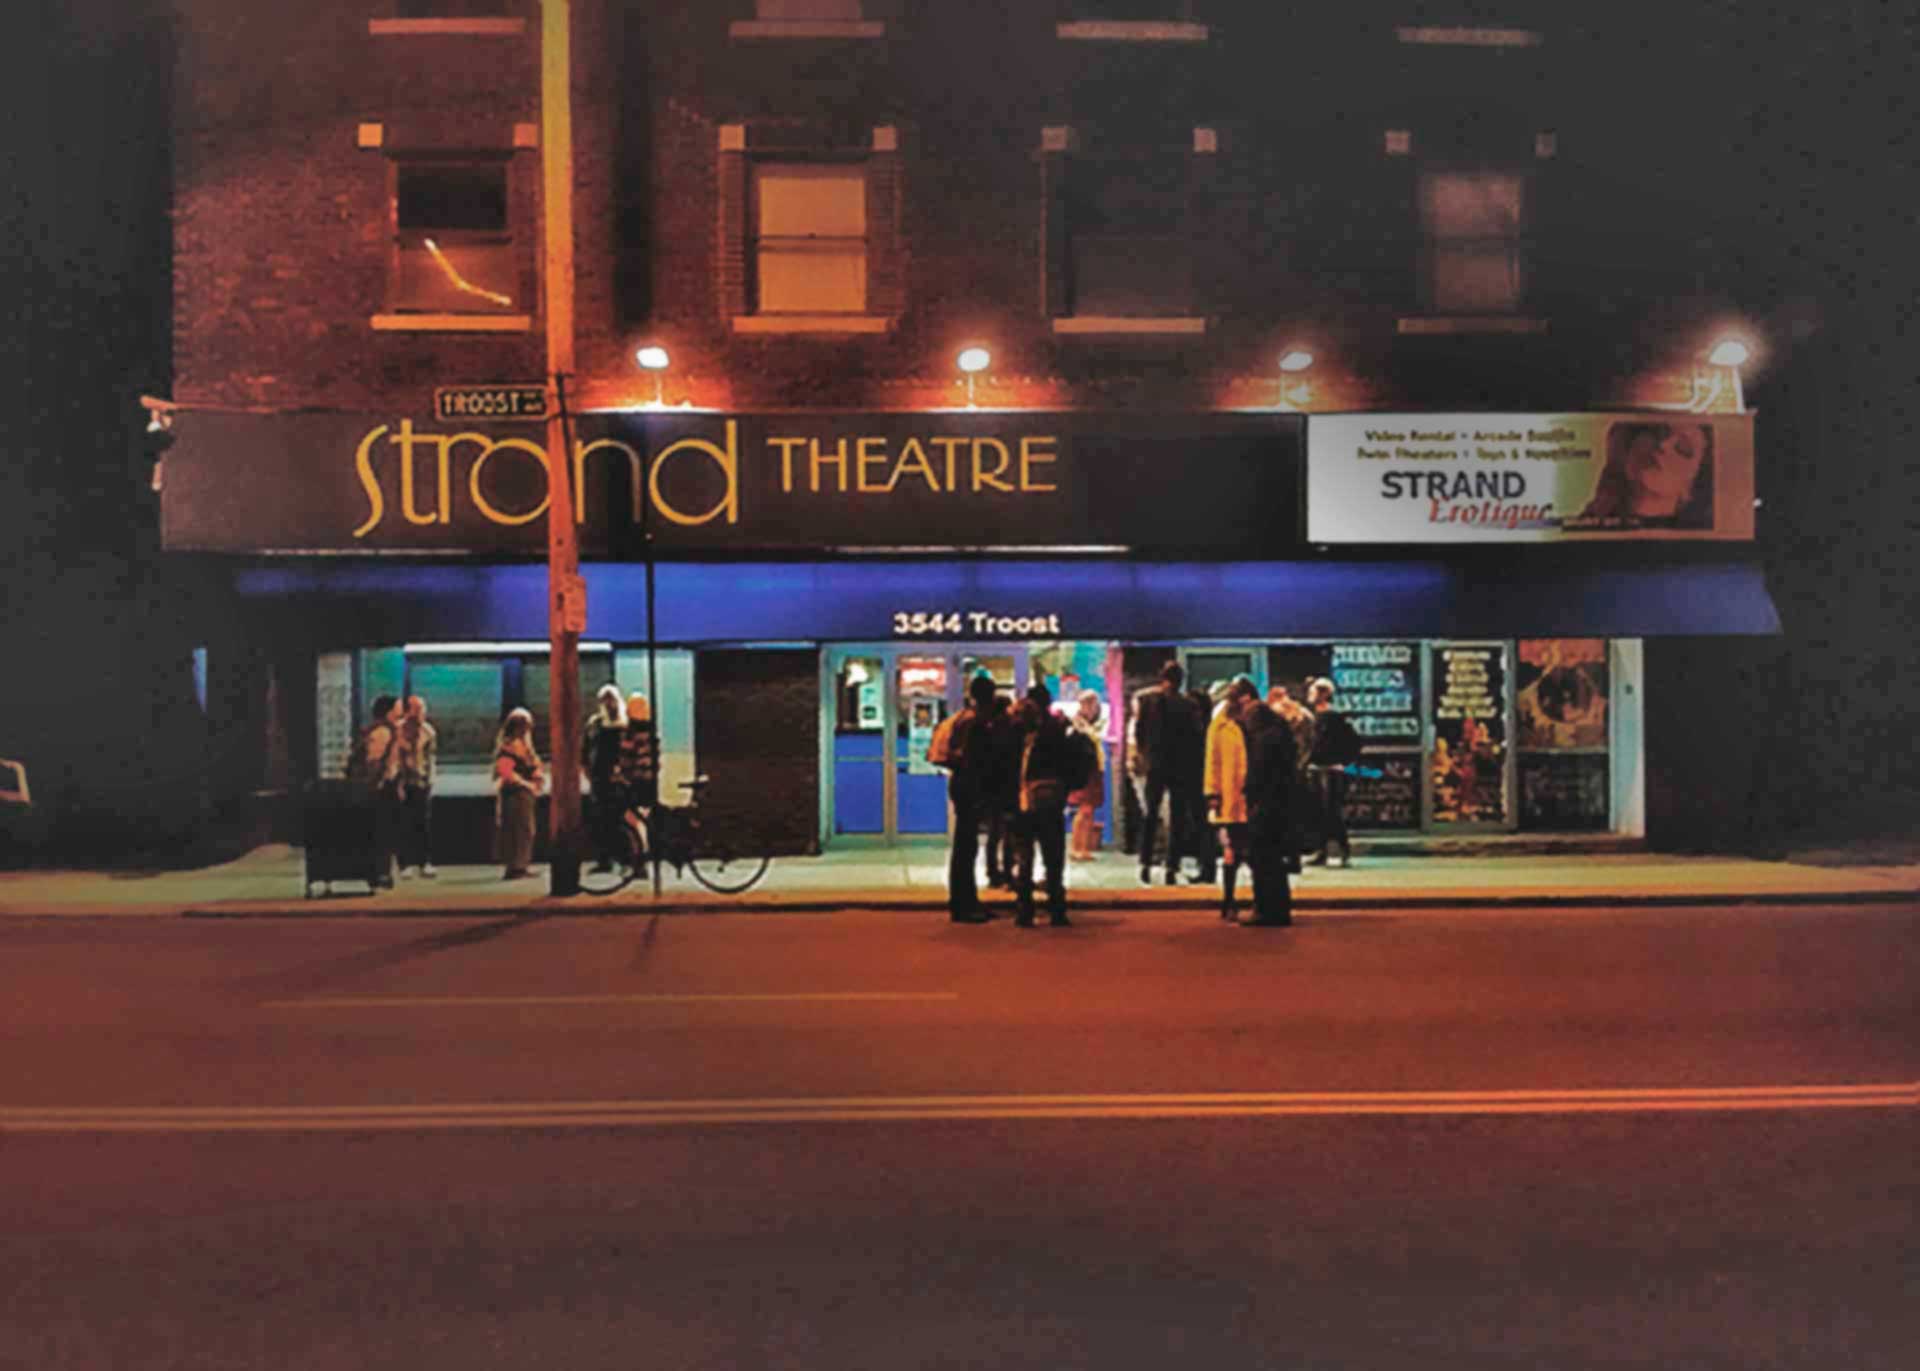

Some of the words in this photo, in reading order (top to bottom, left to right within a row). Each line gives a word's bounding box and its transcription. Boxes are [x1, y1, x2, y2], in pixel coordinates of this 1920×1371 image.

[443, 391, 520, 414] TROOST
[767, 436, 1058, 493] THEATRE
[1381, 470, 1527, 499] STRAND
[1428, 496, 1553, 529] Erotique
[893, 612, 962, 634] 3544
[968, 612, 1061, 634] Troost
